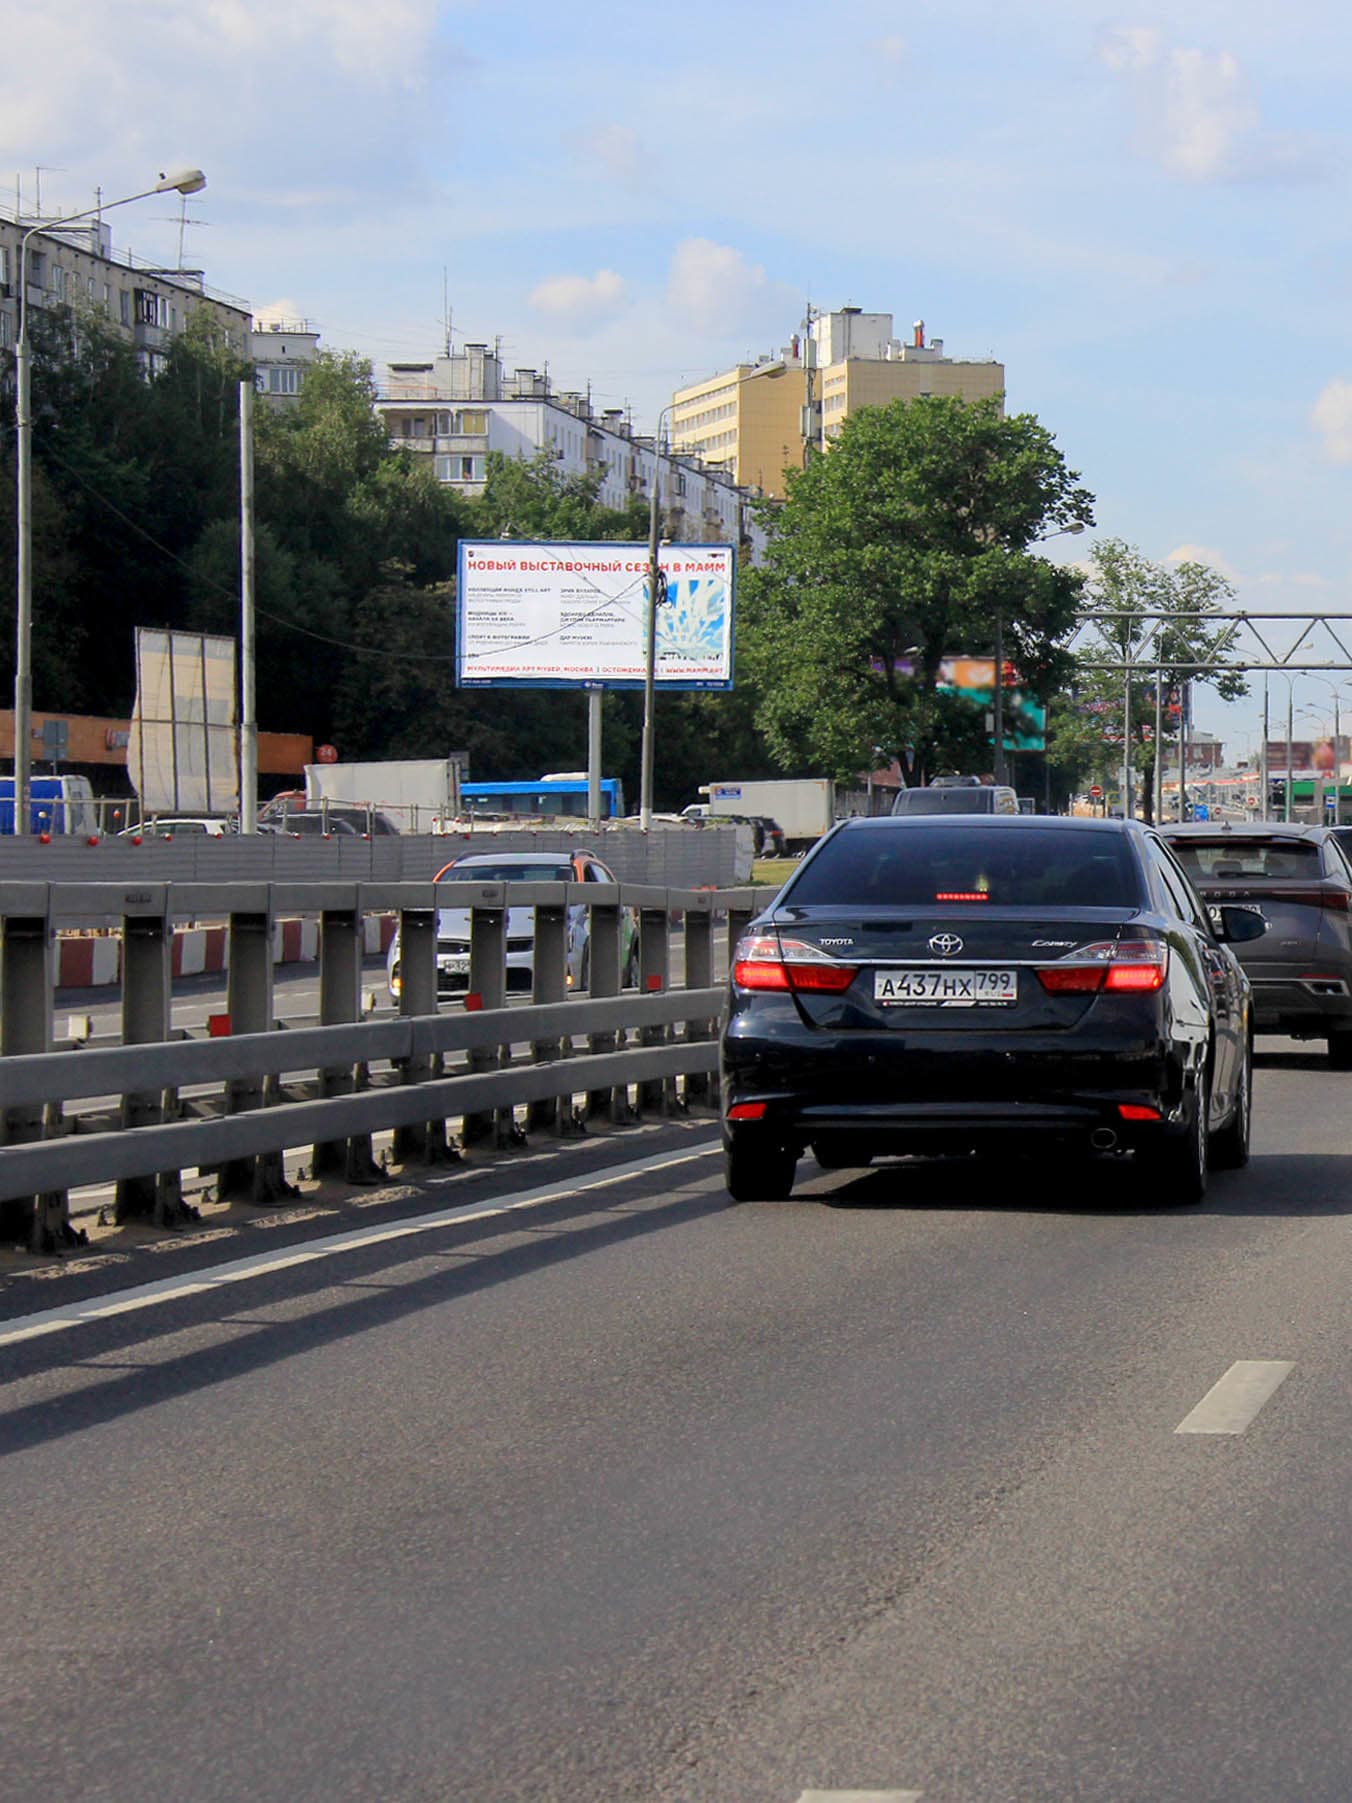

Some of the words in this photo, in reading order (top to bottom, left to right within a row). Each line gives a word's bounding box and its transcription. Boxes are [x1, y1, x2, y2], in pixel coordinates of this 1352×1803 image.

[468, 560, 516, 571] НОВЫЙ
[520, 560, 622, 572] ВЫСТАВОЧНЫЙ
[625, 561, 669, 572] СЕЗН
[673, 563, 681, 572] В
[685, 562, 726, 573] МАММ
[977, 973, 1010, 990] 799
